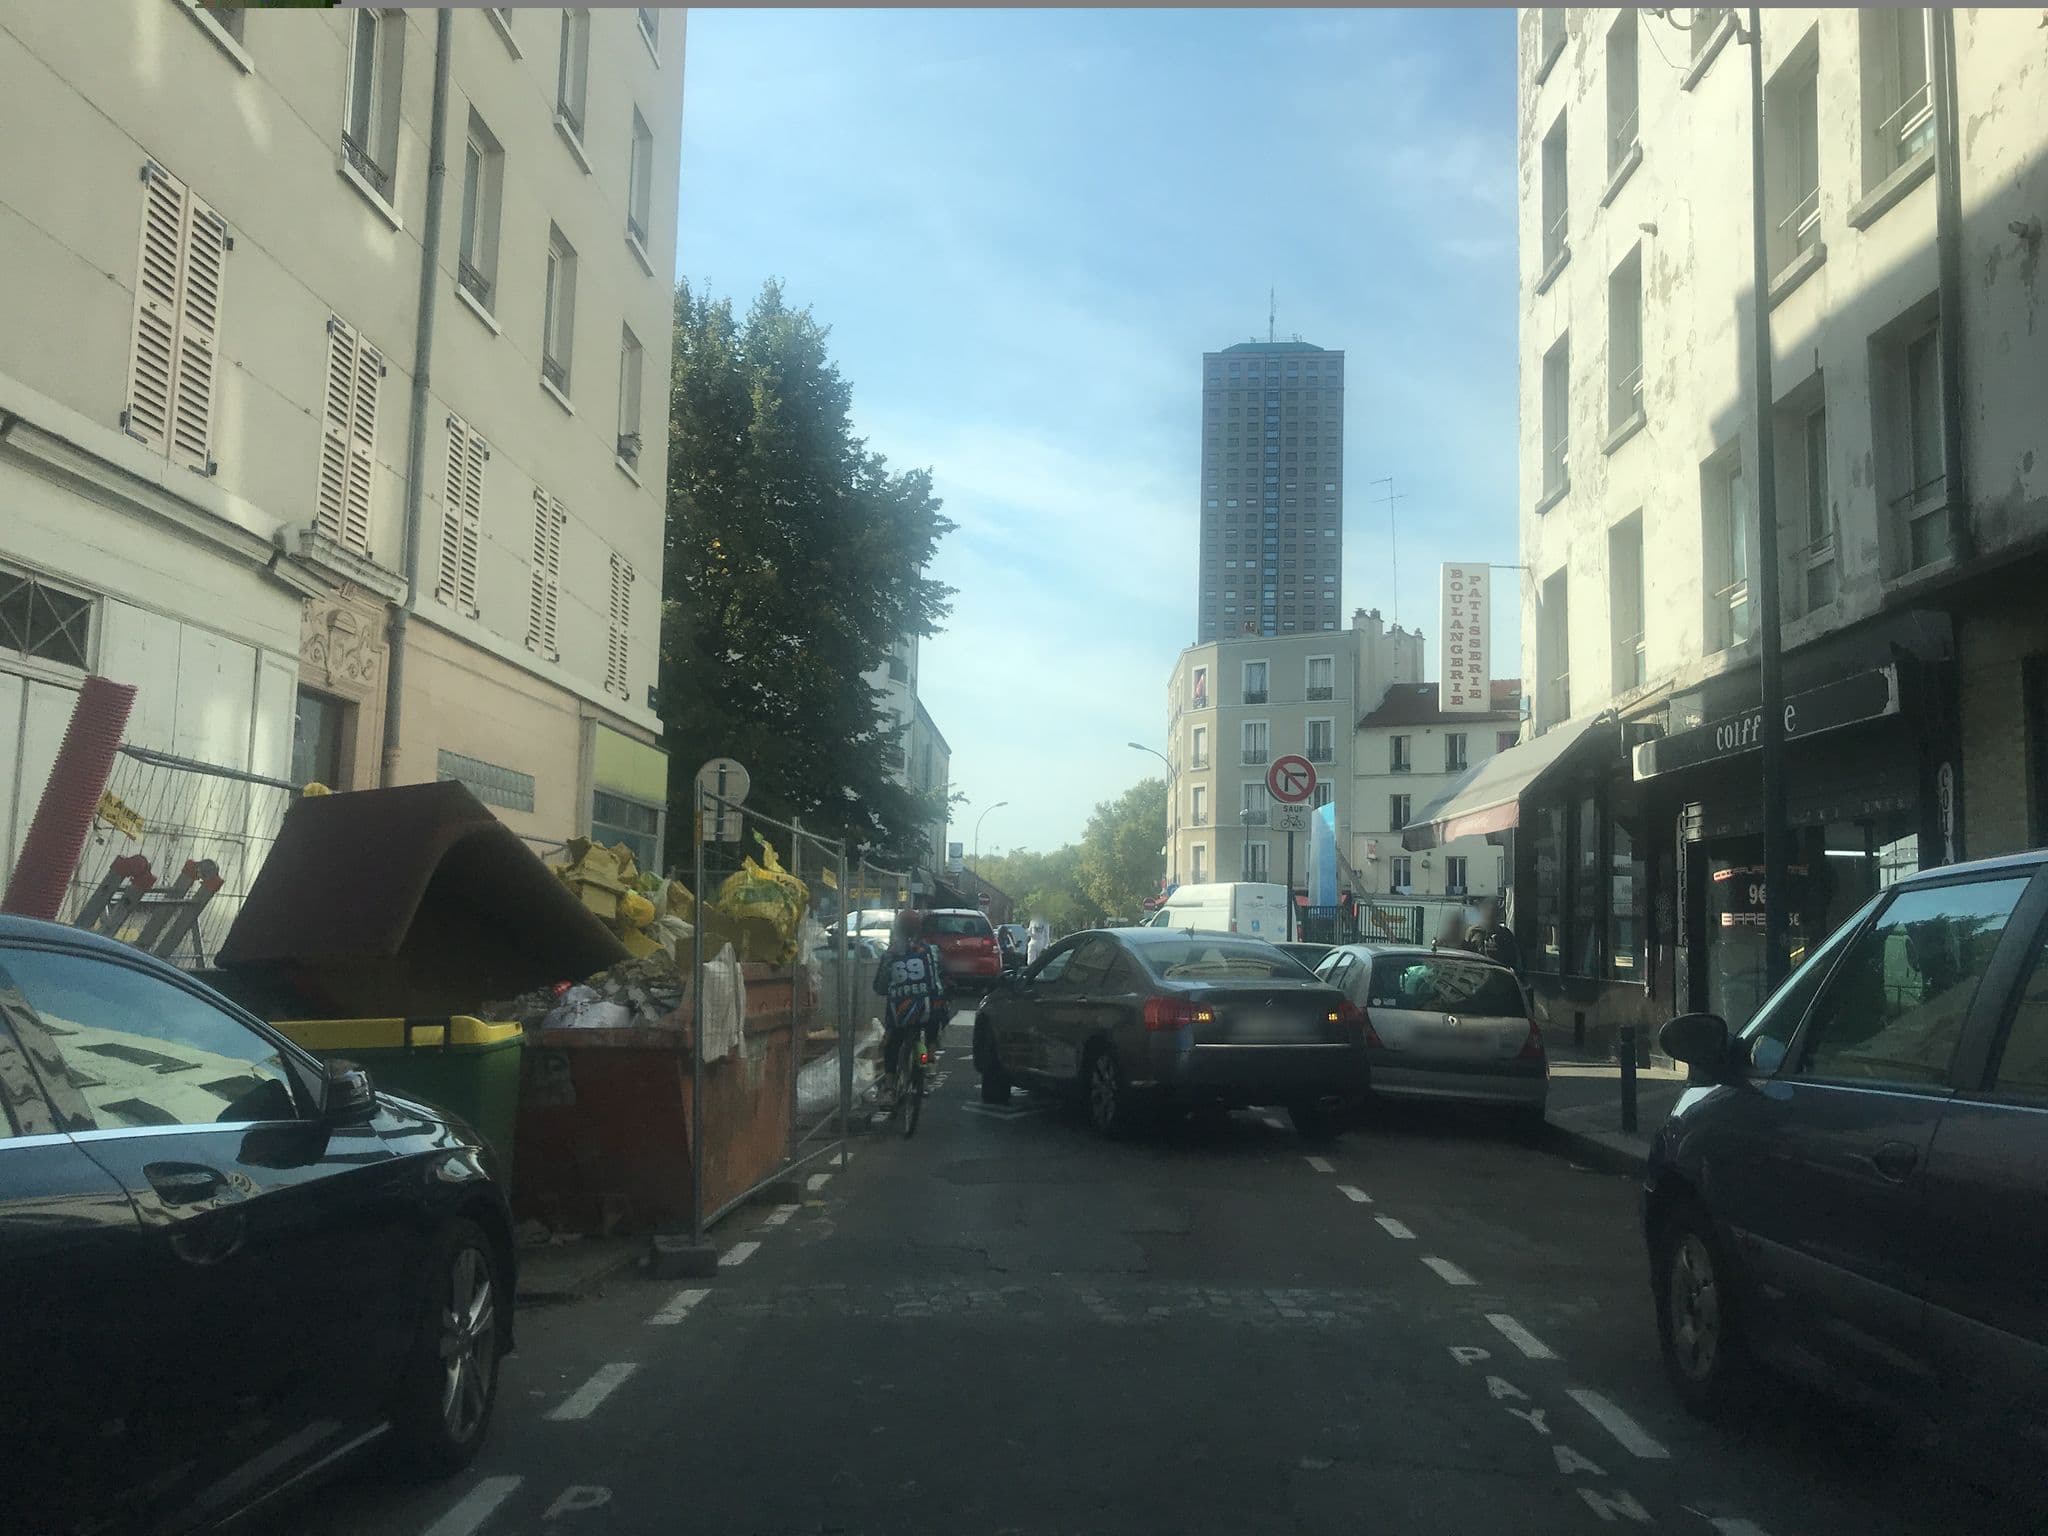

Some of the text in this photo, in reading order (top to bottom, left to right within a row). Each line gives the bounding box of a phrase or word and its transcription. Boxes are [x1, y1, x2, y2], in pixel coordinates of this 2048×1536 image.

[1450, 569, 1464, 705] BOULANGERIE
[1468, 575, 1482, 699] PATISSERIE
[1716, 704, 1796, 751] coiffe
[1282, 804, 1304, 814] SAUF
